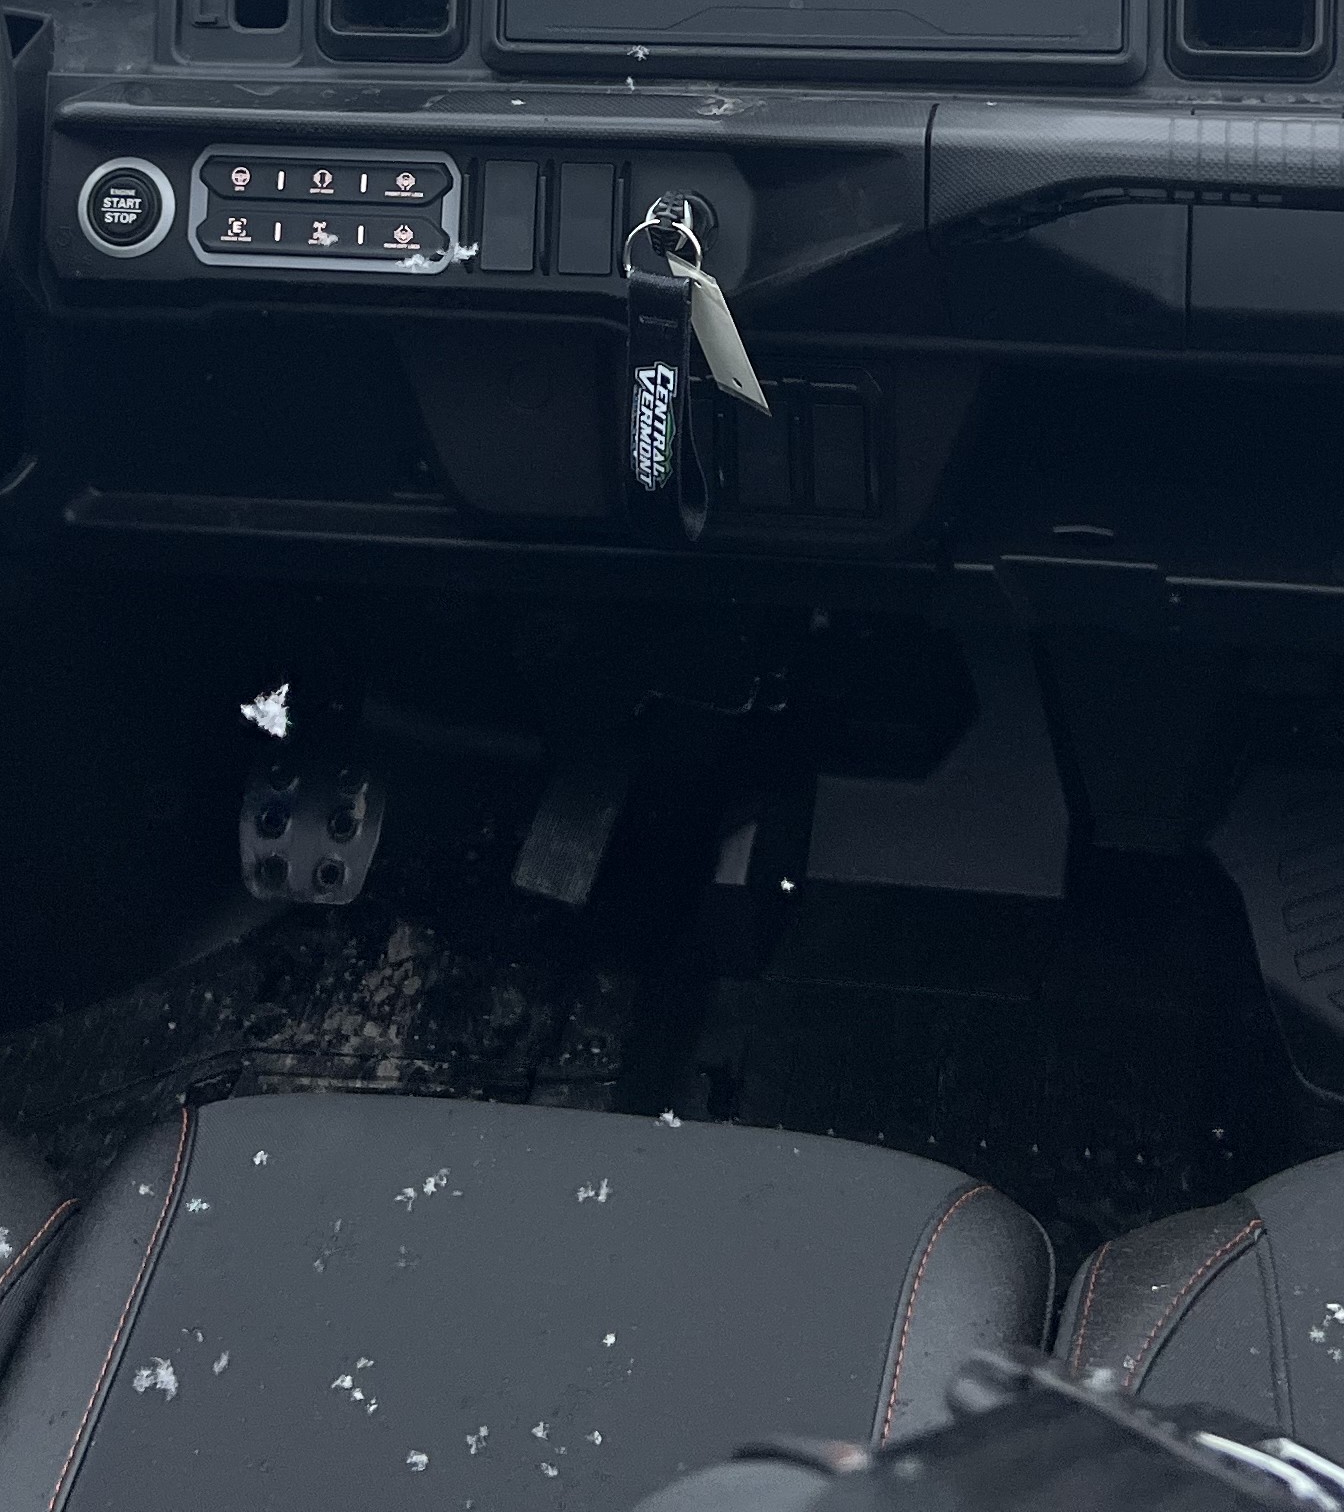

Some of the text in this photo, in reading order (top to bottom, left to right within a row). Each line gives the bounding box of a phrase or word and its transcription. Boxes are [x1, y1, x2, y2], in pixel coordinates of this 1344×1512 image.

[103, 197, 142, 209] START
[104, 213, 137, 223] STOP
[638, 369, 656, 487] VERMONT
[654, 364, 674, 477] CENTRAL
